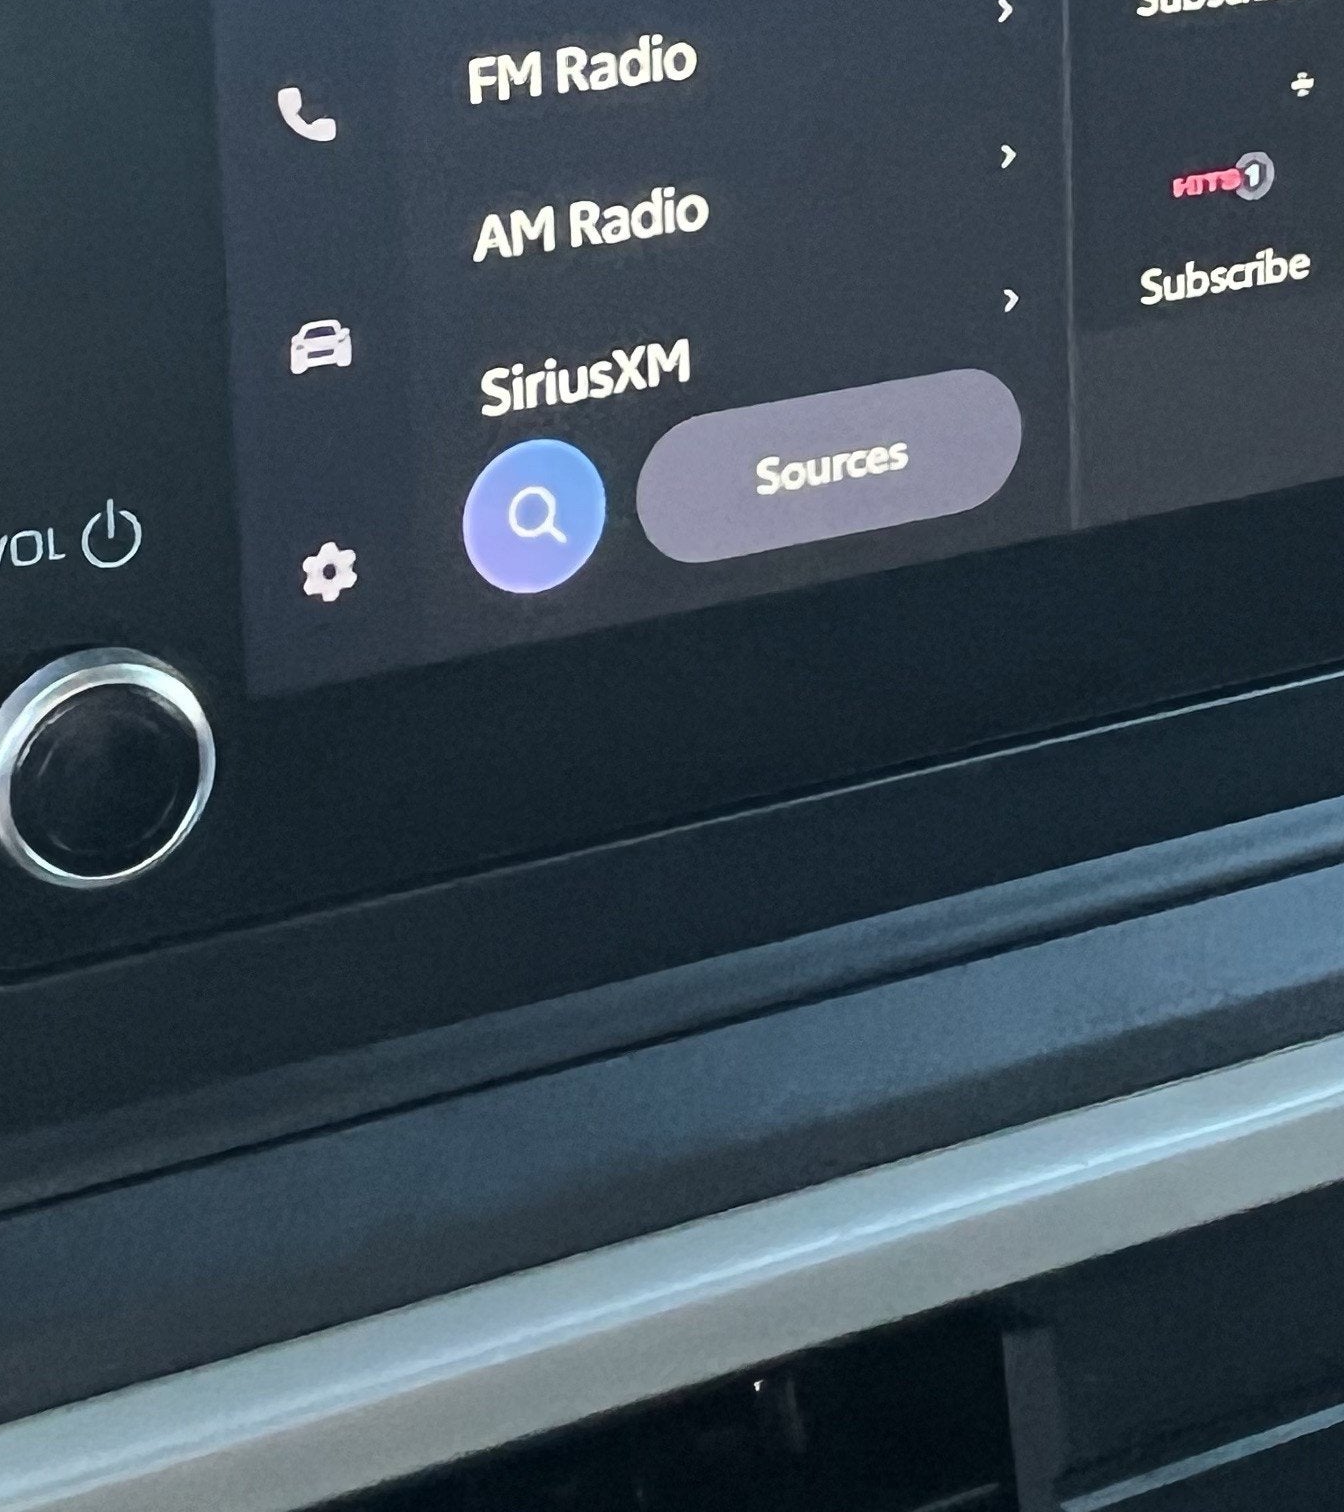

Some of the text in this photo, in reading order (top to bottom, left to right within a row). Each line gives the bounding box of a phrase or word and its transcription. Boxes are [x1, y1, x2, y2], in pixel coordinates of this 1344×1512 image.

[468, 33, 698, 105] FM Radio
[472, 186, 710, 264] AM Radio
[1140, 247, 1311, 306] Subscribe
[480, 338, 691, 418] SiriusXM
[756, 441, 910, 496] Sources
